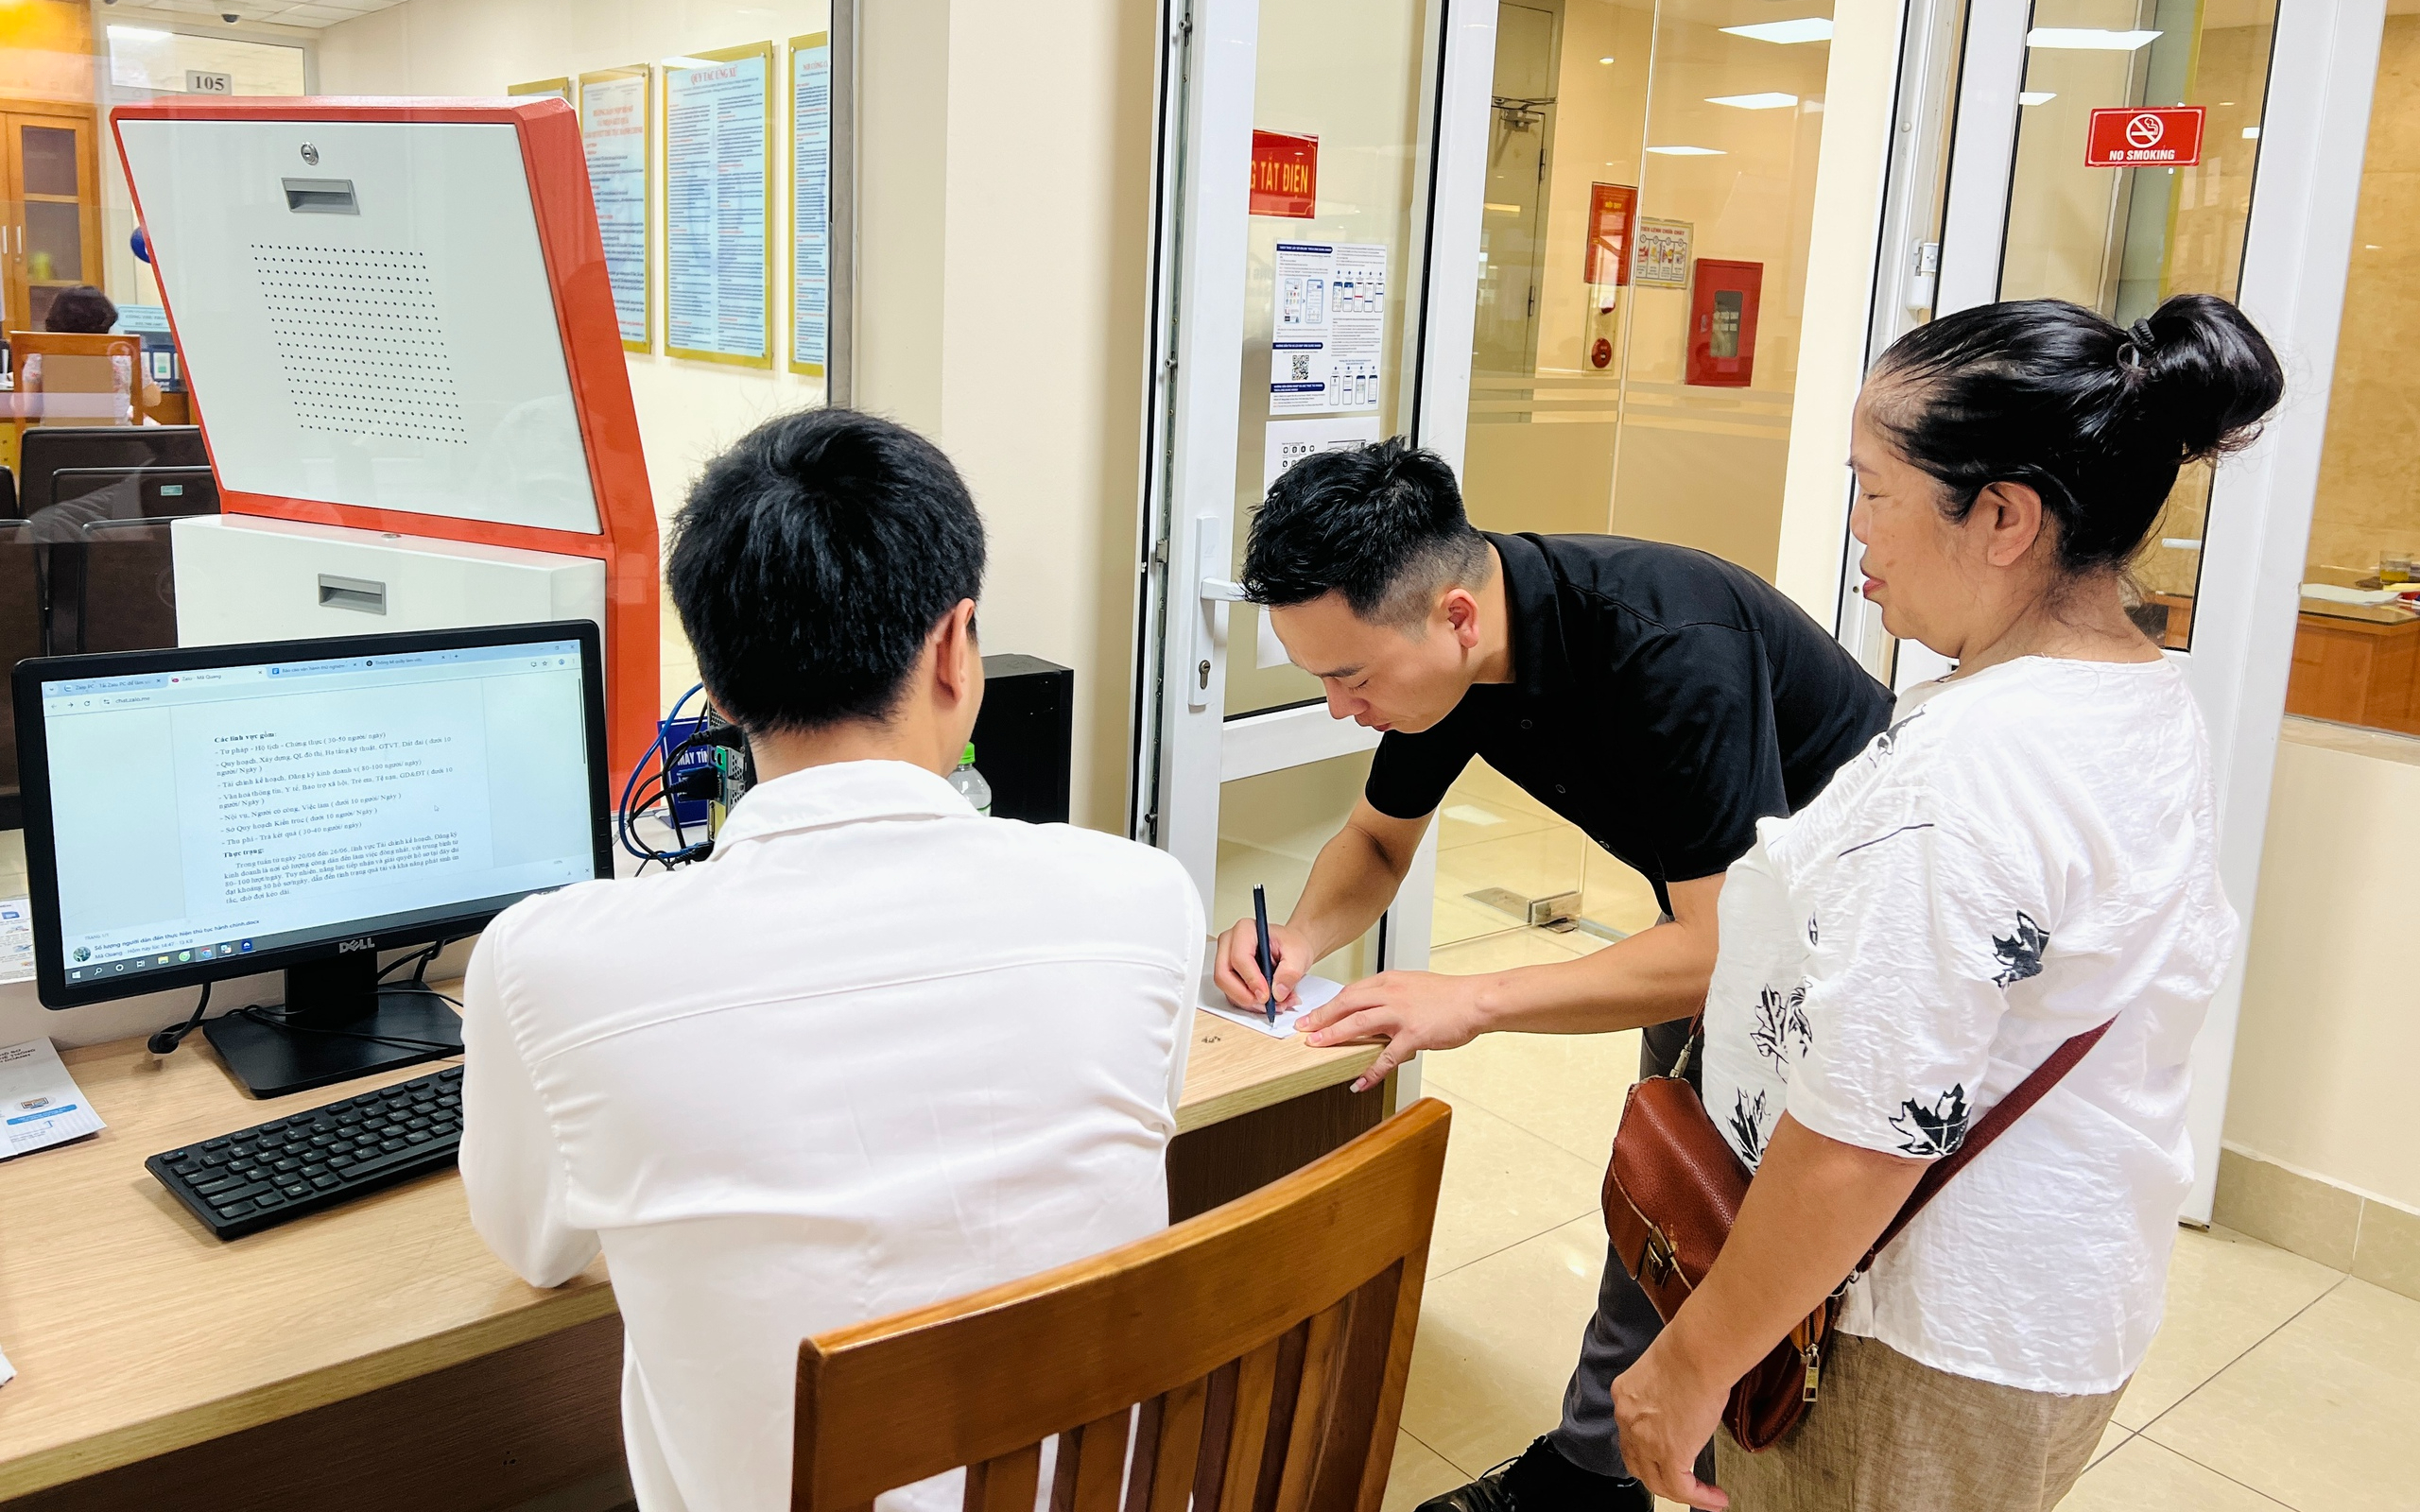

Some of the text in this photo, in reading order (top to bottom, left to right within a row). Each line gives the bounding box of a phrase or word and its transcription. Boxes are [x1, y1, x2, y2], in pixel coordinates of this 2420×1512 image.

[196, 76, 224, 91] 105
[2109, 149, 2175, 161] NO SMOKING
[1260, 151, 1280, 191] TẮT
[1283, 157, 1309, 200] ĐIỆN
[339, 937, 375, 954] DELL
